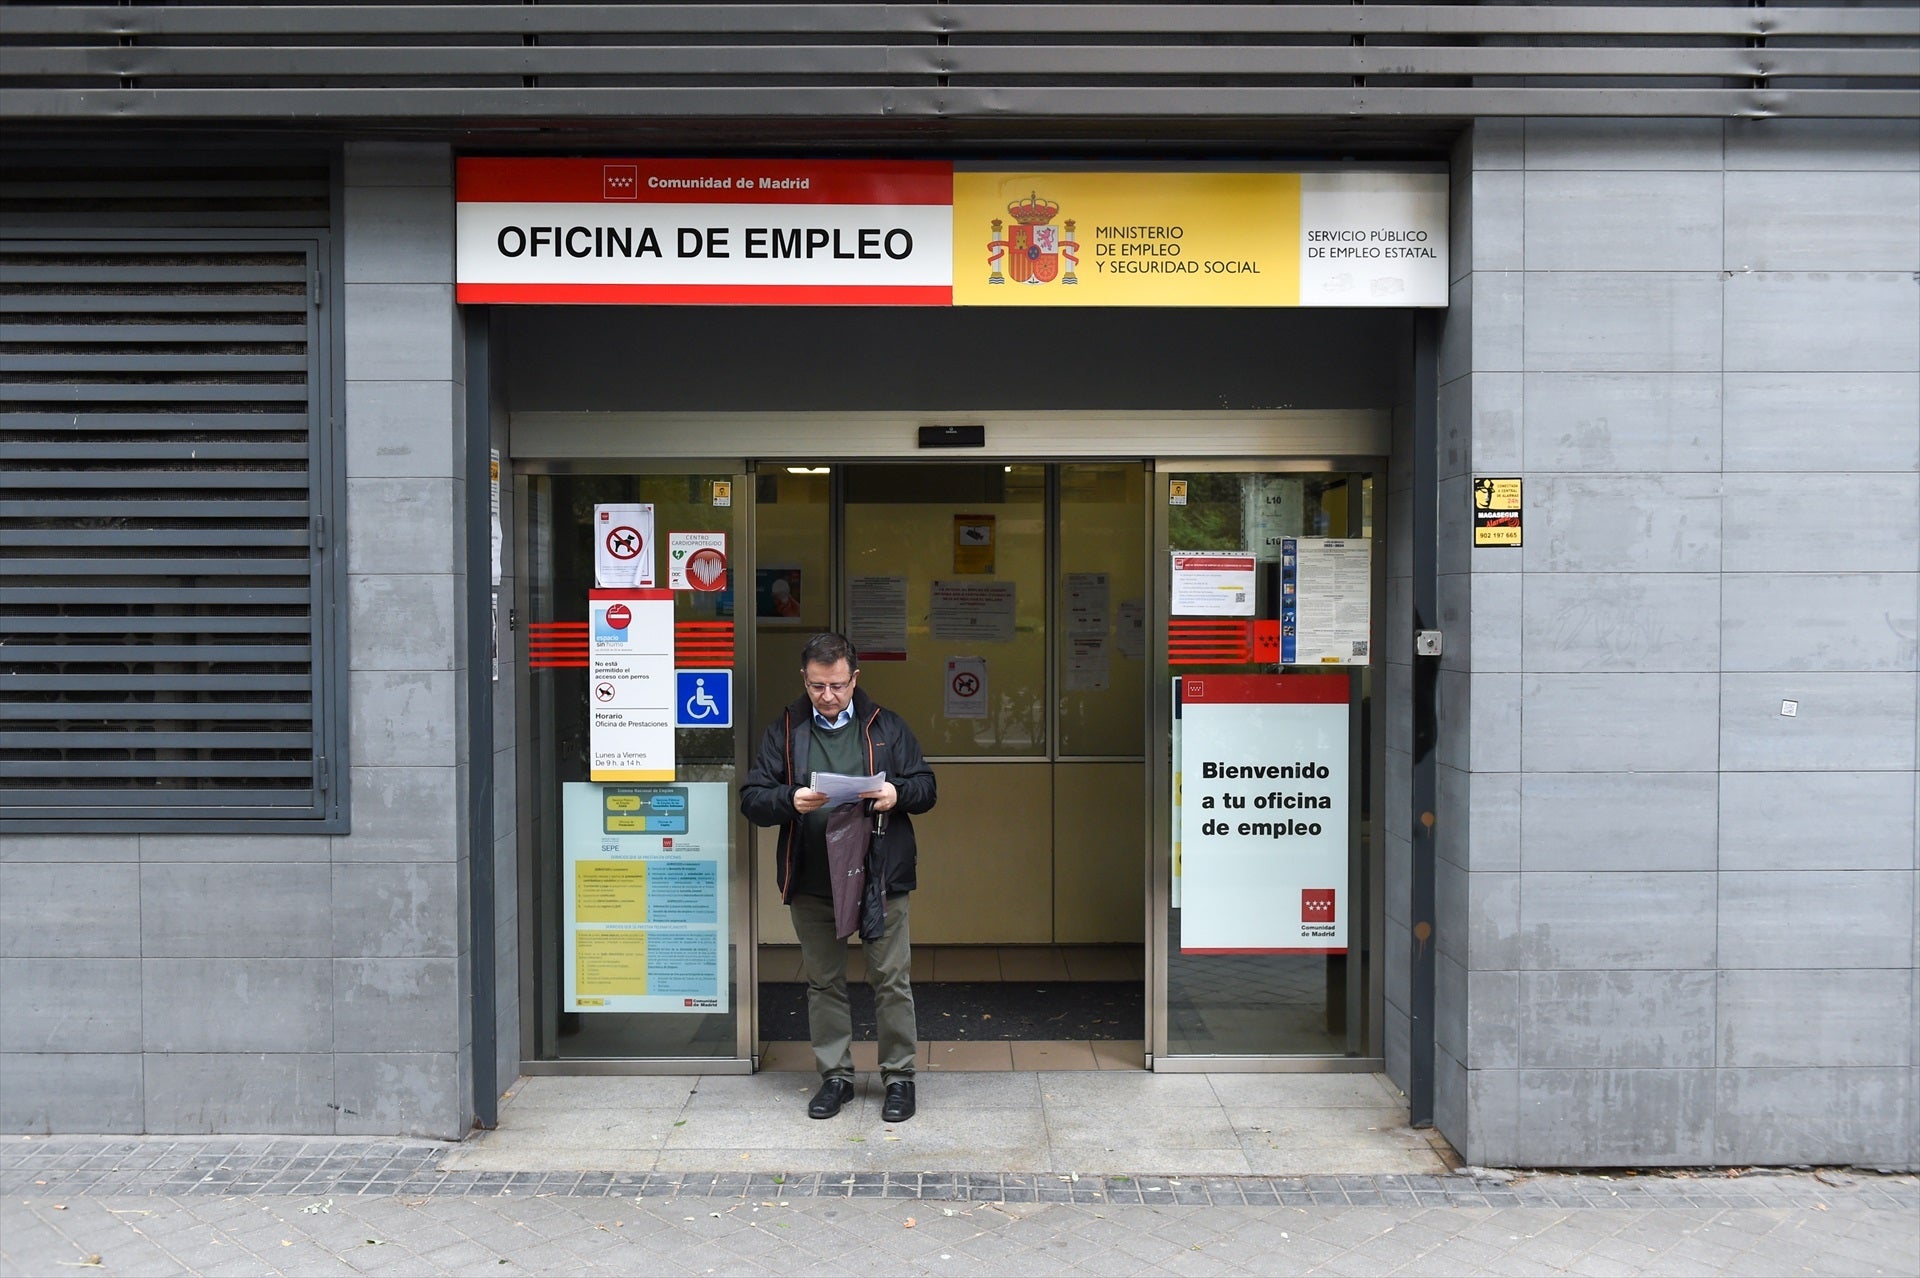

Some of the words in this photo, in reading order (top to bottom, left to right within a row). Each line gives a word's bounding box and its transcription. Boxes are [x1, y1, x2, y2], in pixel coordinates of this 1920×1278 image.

[648, 177, 732, 189] Comunidad
[735, 177, 755, 189] de
[758, 177, 810, 190] Madrid
[1096, 226, 1184, 240] MINISTERIO
[1308, 230, 1367, 243] SERVICIO
[1370, 227, 1428, 243] PÚBLICO
[497, 226, 662, 259] OFICINA
[676, 227, 730, 259] DE
[745, 228, 914, 260] EMPLEO
[1096, 244, 1118, 257] DE
[1121, 244, 1181, 257] EMPLEO
[1308, 247, 1327, 259] DE
[1330, 247, 1381, 259] EMPLEO
[1385, 247, 1437, 259] ESTATAL
[1096, 261, 1106, 274] Y
[1109, 261, 1199, 275] SEGURIDAD
[1204, 260, 1261, 274] SOCIAL
[1266, 496, 1282, 505] L10
[1202, 762, 1330, 779] Bienvenido
[1202, 796, 1215, 809] a
[1223, 793, 1246, 809] tu
[1254, 792, 1331, 809] oficina
[1202, 819, 1229, 836] de
[1238, 819, 1322, 839] empleo
